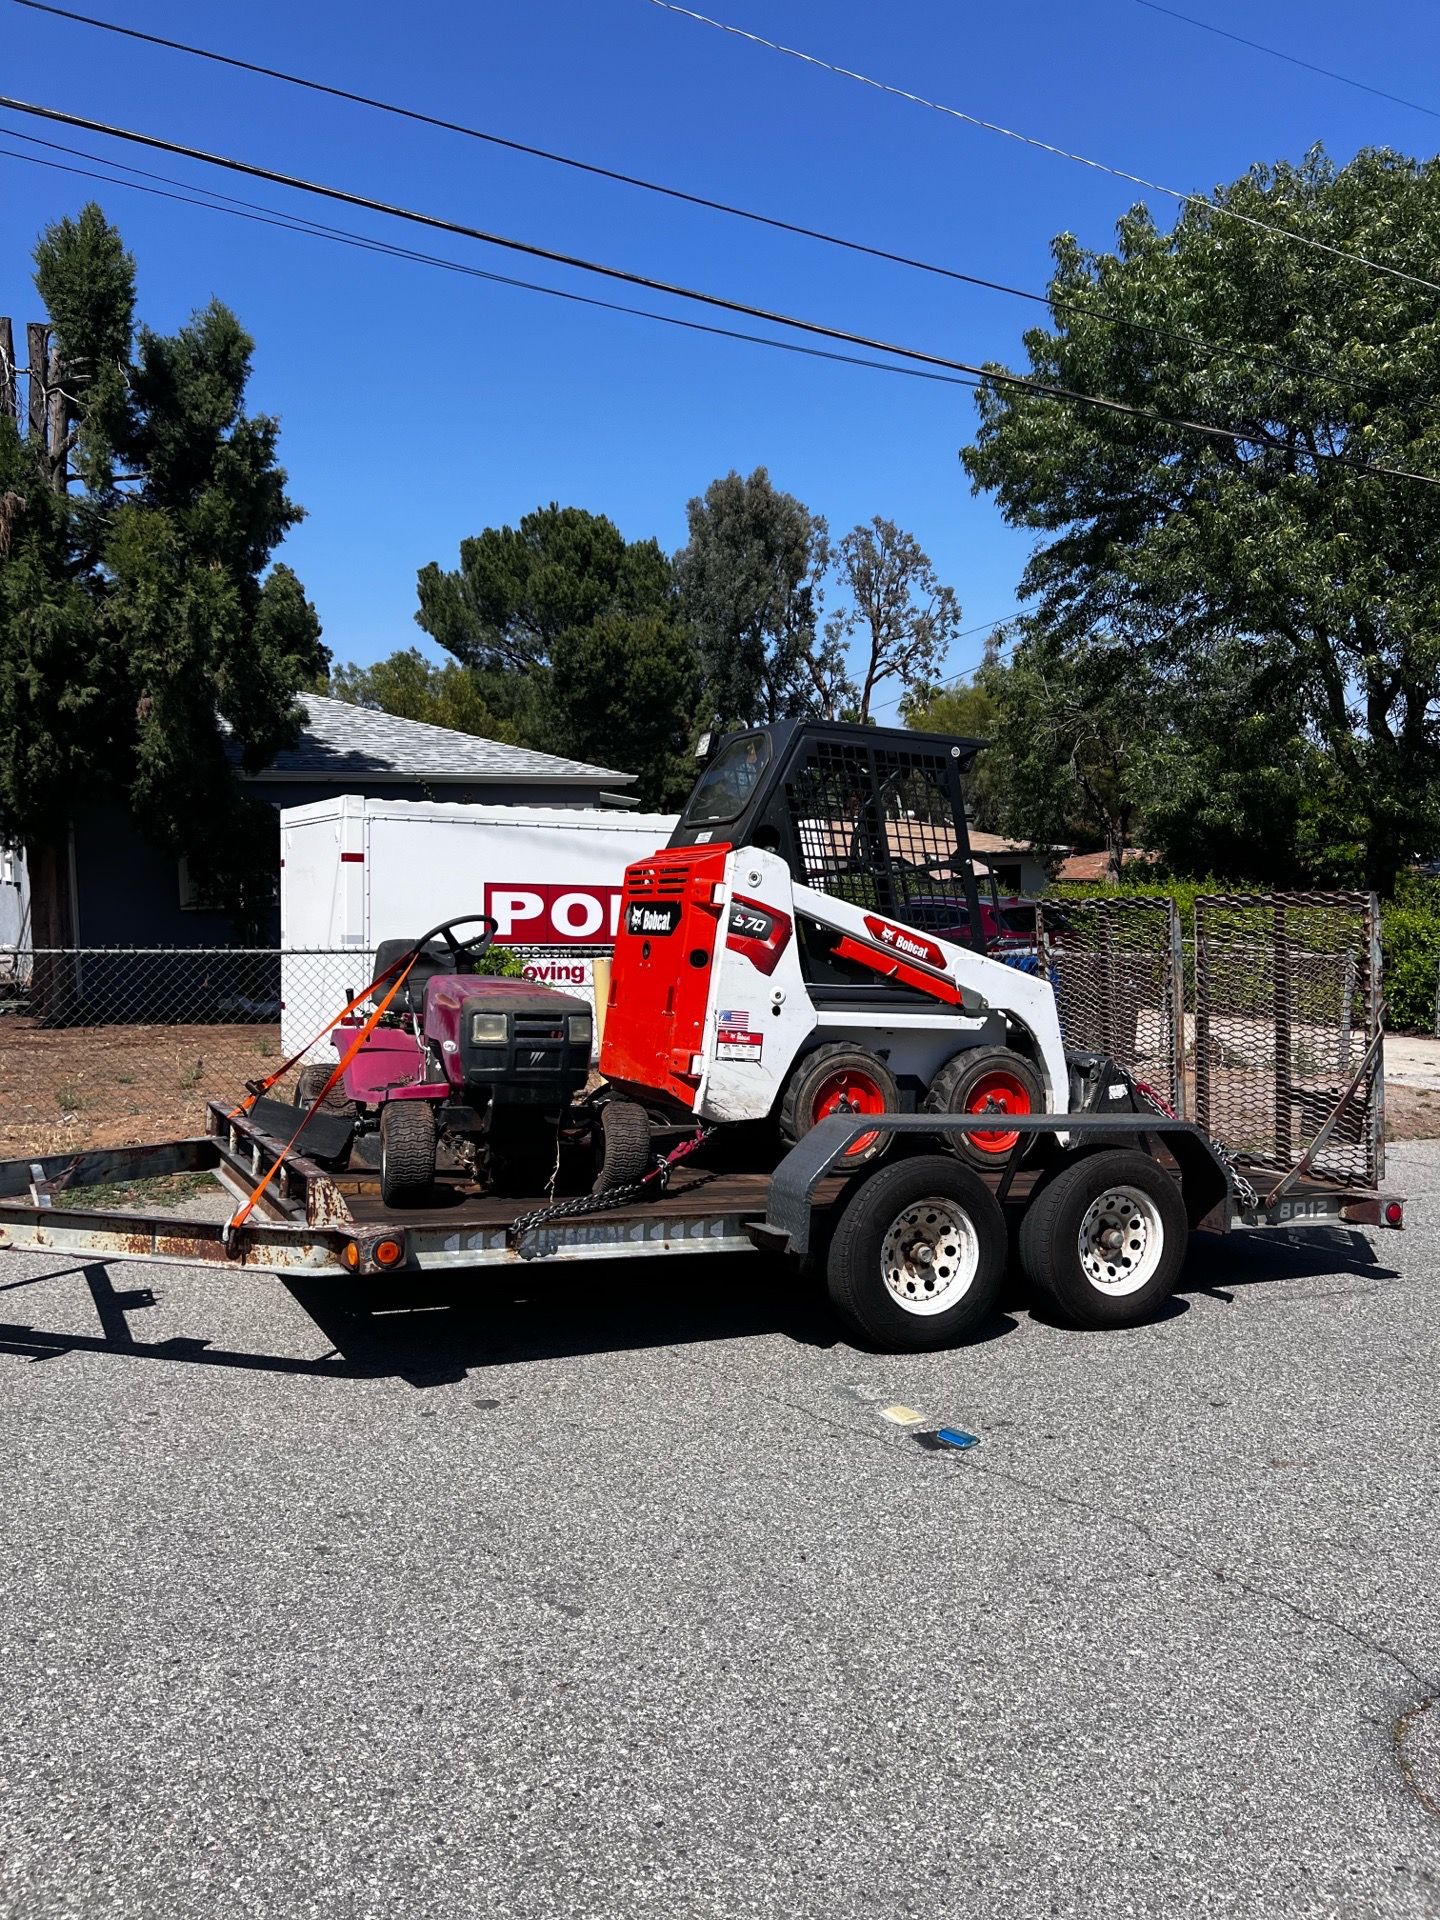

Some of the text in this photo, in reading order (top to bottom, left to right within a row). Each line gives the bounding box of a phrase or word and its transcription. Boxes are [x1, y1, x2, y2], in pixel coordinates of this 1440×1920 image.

[643, 910, 671, 930] Bobcat
[732, 914, 767, 932] S70
[896, 934, 929, 959] Bobcat
[522, 961, 585, 984] oving
[1279, 1201, 1328, 1219] 8012
